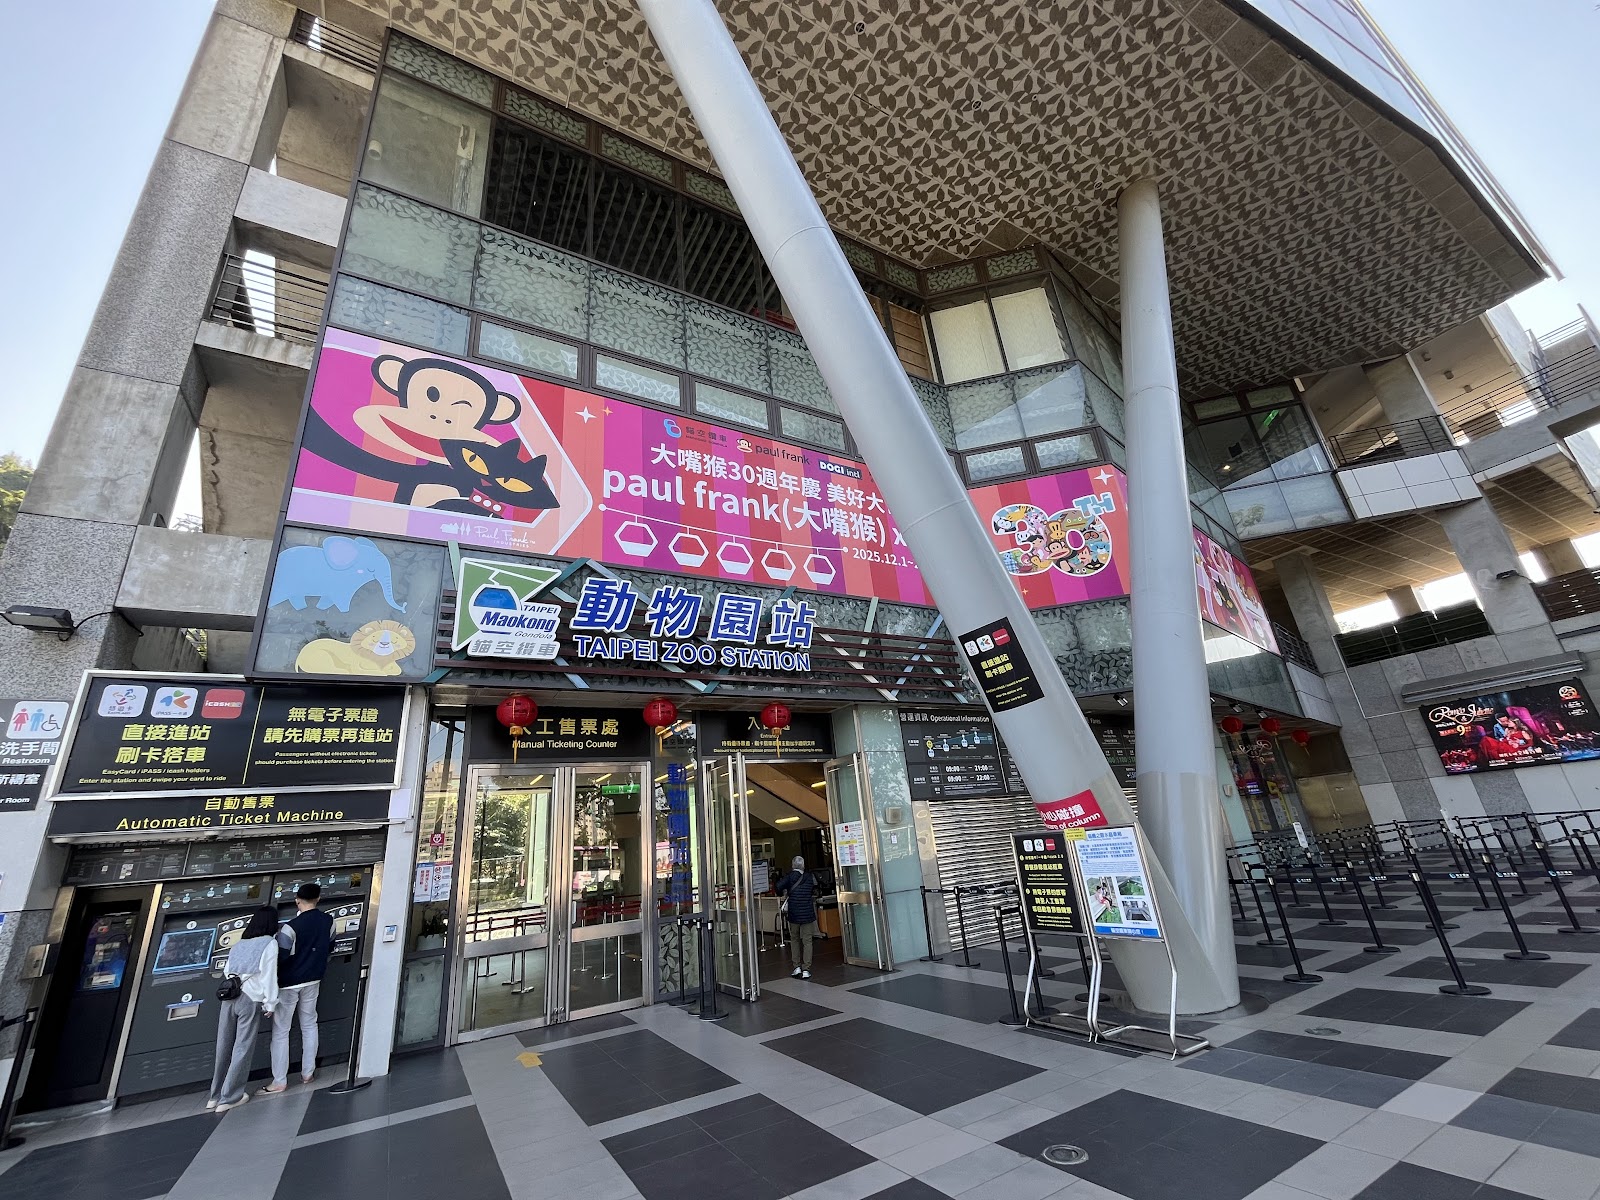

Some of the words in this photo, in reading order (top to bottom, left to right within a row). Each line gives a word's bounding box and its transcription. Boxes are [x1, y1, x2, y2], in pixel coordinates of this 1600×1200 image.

[755, 444, 780, 458] paul
[781, 450, 811, 465] frank
[650, 442, 822, 500] 大嘴猴30週年慶
[827, 482, 892, 515] 美好大
[819, 461, 844, 475] DOGI
[846, 469, 860, 479] intl
[602, 468, 686, 506] paul
[693, 480, 886, 548] frank(大嘴猴)
[474, 525, 500, 539] Paul
[502, 529, 529, 544] Frank
[992, 504, 1112, 577] 30
[1073, 492, 1116, 518] TH
[852, 547, 919, 570] 2025.12.1~
[523, 604, 558, 615] TAIPEI
[569, 577, 816, 649] 動物園站
[480, 611, 556, 633] Maokong
[514, 631, 553, 640] Gondola
[471, 639, 557, 657] 貓空纜車
[573, 636, 658, 662] TAIPEI
[662, 644, 717, 666] ZOO
[721, 647, 811, 672] STATION
[287, 706, 379, 723] 無電子票證
[930, 714, 960, 723] Operational
[960, 714, 990, 723] Information
[121, 723, 212, 741] 直接進站
[263, 727, 394, 743] 請先購票再進站
[521, 717, 619, 736] 工售票處
[0, 741, 60, 756] 洗手間
[512, 739, 545, 749] Manual
[547, 739, 584, 750] Ticketing
[586, 739, 618, 748] Counter
[114, 746, 207, 764] 刷卡搭車
[205, 795, 276, 811] 自動售票
[116, 814, 212, 831] Automatic
[219, 812, 270, 825] Ticket
[276, 810, 344, 823] Machine
[1059, 822, 1067, 830] of
[1068, 812, 1101, 828] column
